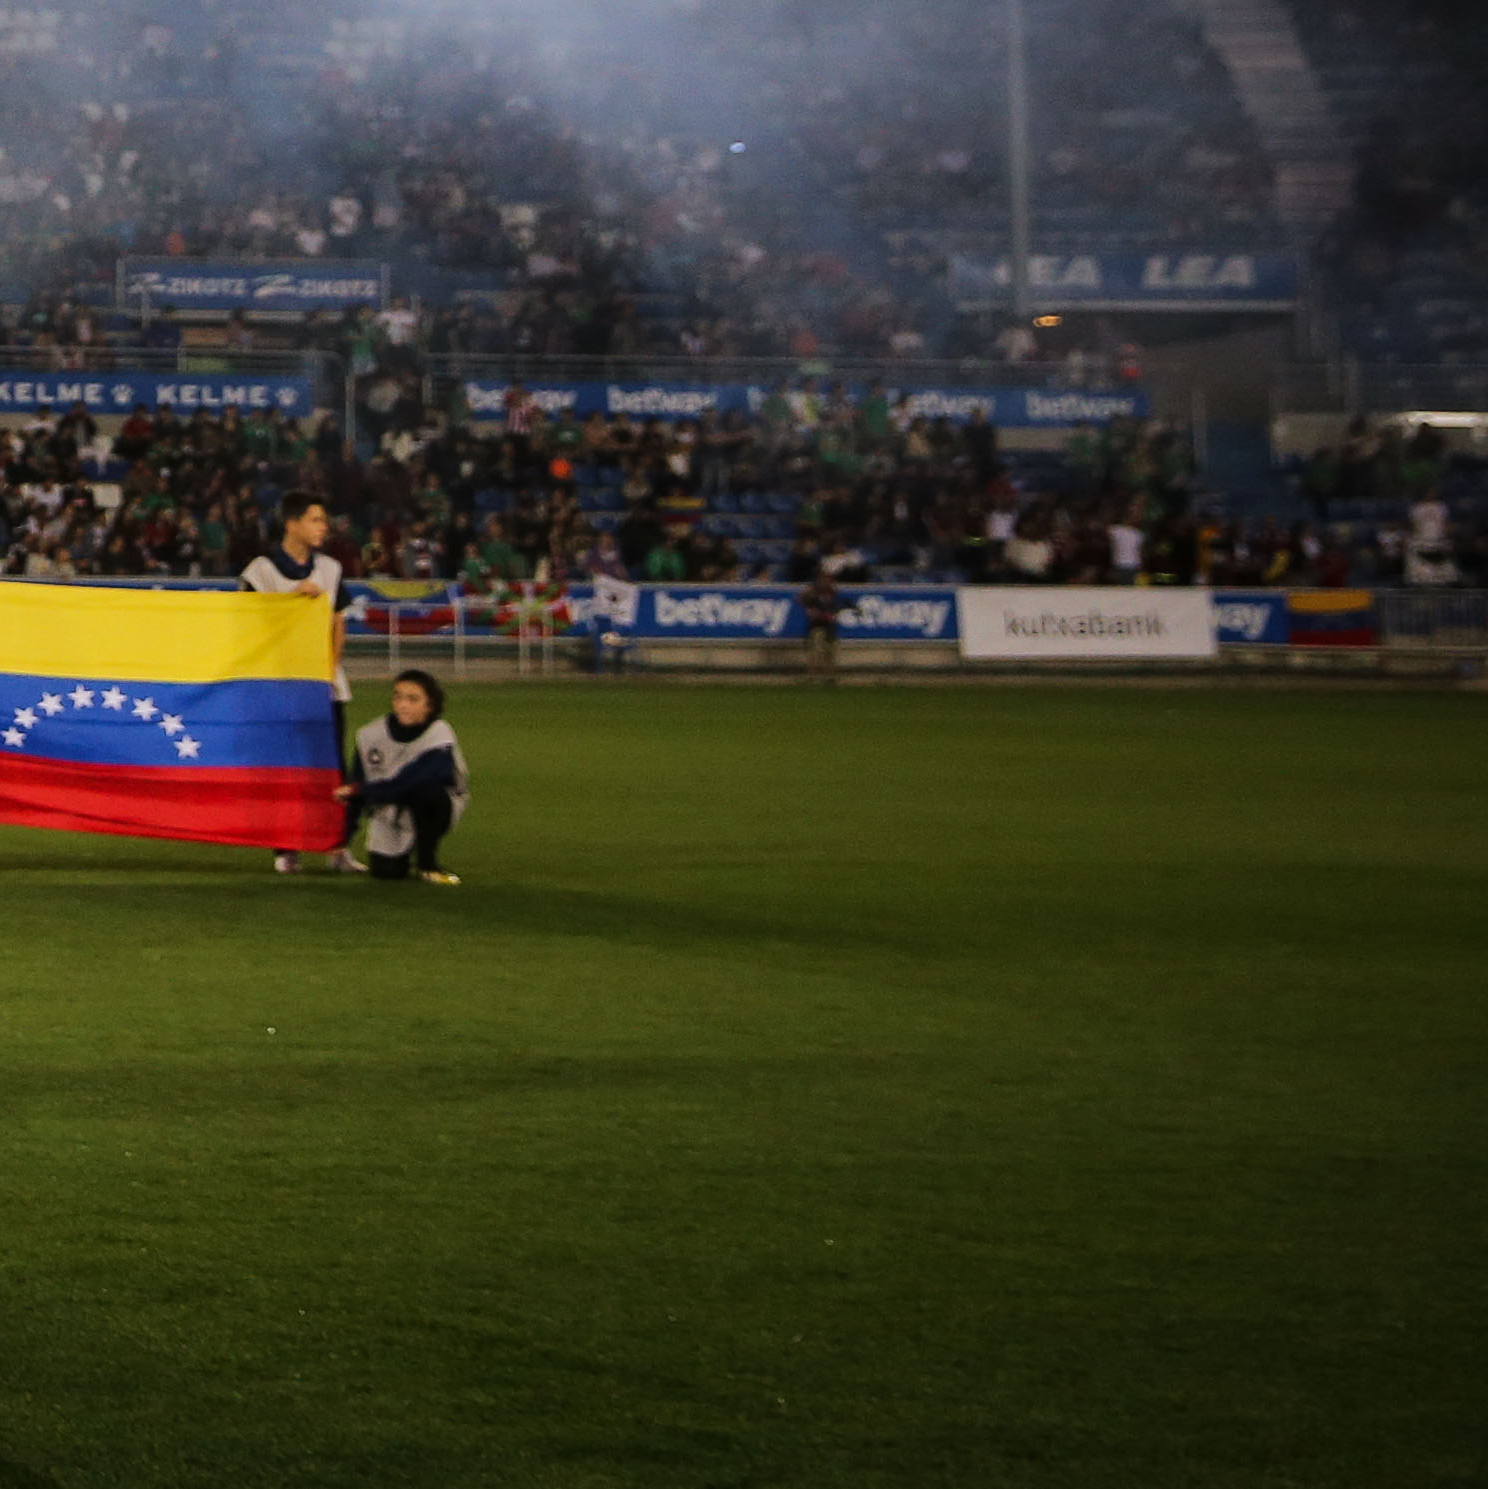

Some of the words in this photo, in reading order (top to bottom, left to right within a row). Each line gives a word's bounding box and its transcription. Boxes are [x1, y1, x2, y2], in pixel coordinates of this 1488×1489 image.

[1141, 256, 1254, 290] LEA
[156, 384, 271, 407] KELME
[653, 591, 792, 636] betway
